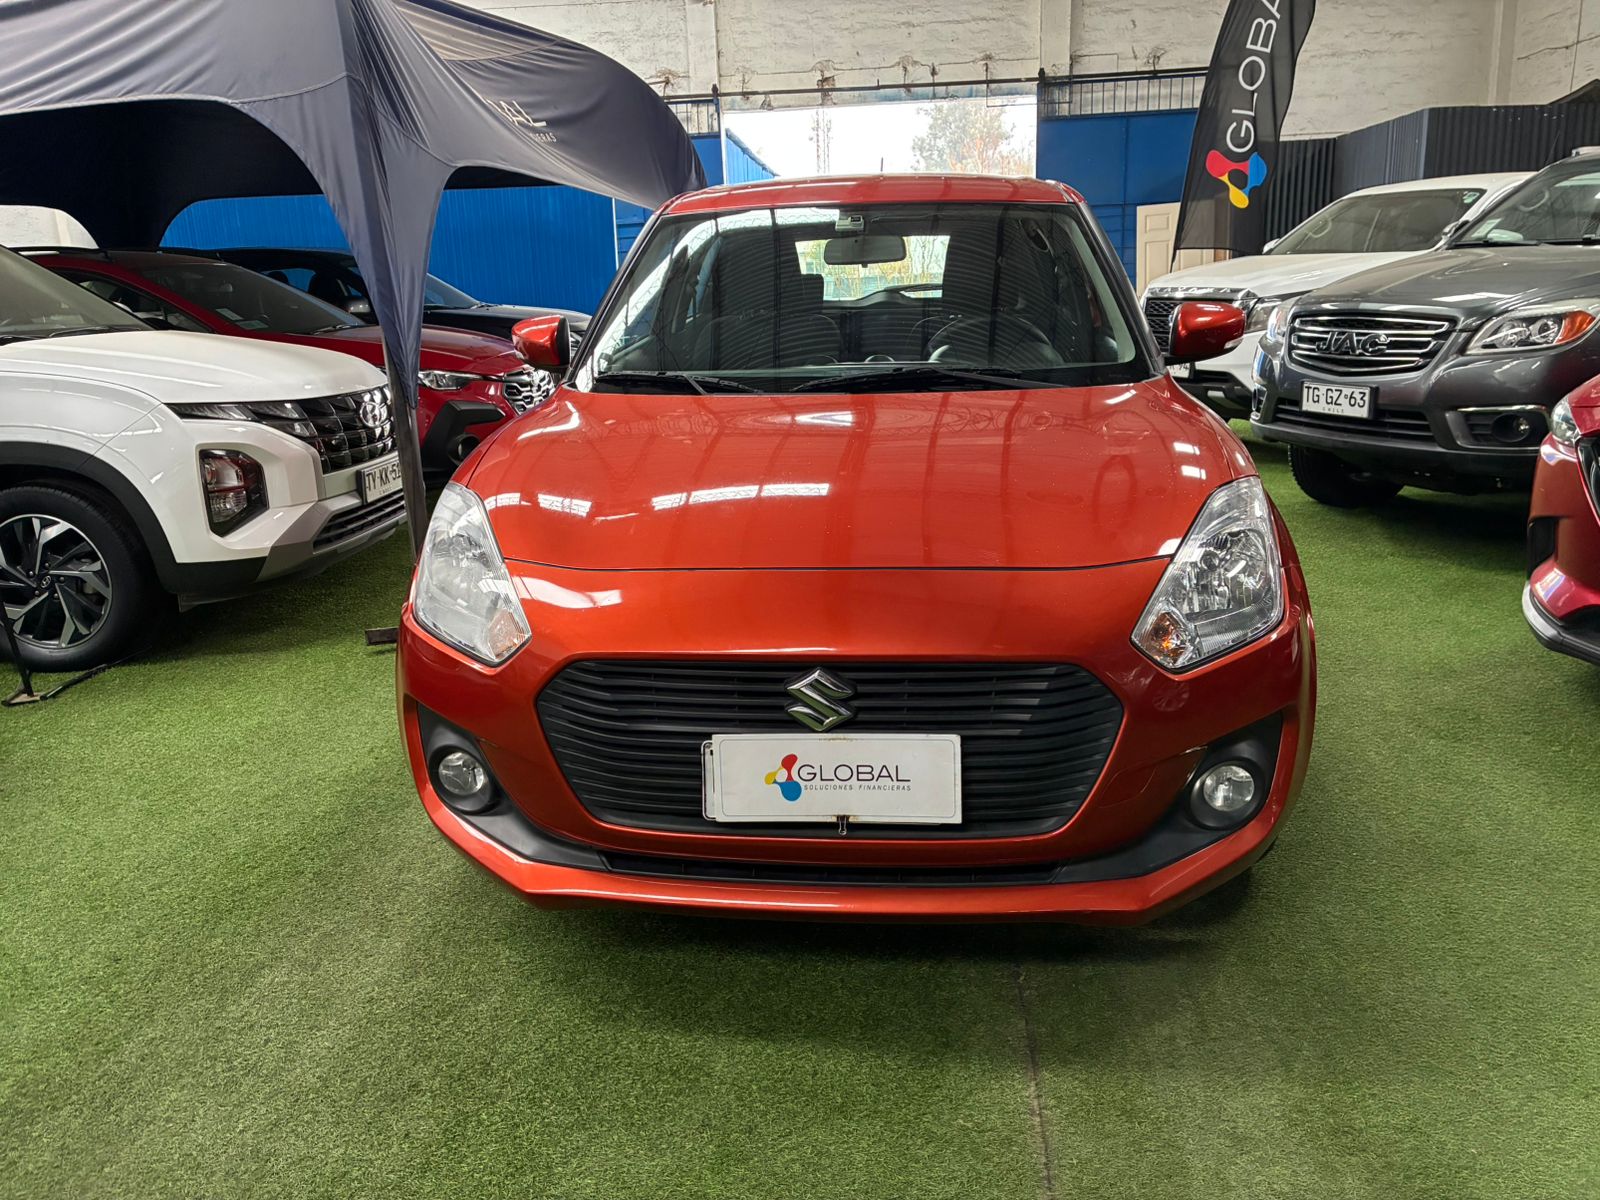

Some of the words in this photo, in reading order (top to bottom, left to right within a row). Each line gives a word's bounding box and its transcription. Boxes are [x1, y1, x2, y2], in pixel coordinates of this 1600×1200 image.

[1315, 331, 1388, 356] JAC
[797, 764, 911, 782] GLOBAL
[859, 784, 912, 792] FINANCIERAS
